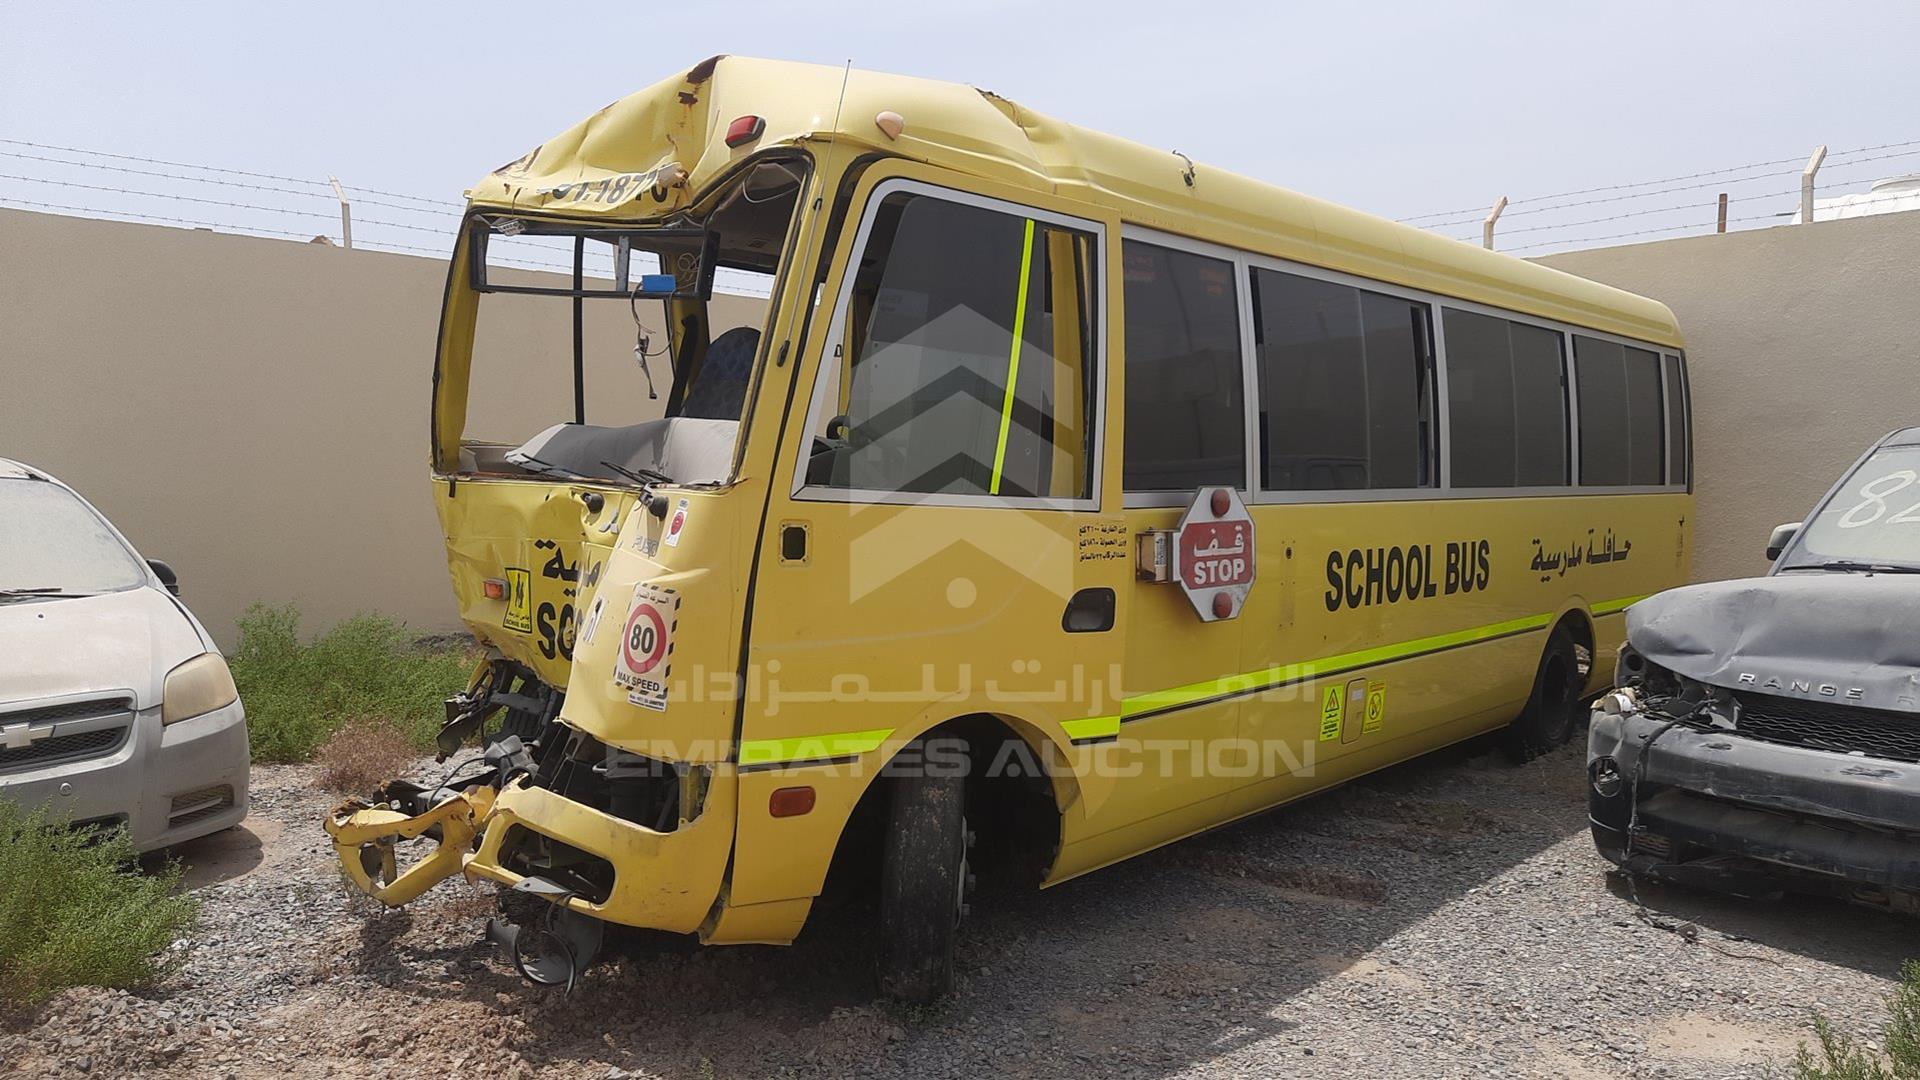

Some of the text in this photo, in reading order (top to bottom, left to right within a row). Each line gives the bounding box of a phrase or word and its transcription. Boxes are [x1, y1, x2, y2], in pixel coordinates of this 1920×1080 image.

[1194, 524, 1245, 557] قف
[1586, 527, 1632, 565] حافلة
[1194, 558, 1245, 585] STOP
[1325, 539, 1490, 612] SCHOOL BUS
[1530, 538, 1583, 583] مدرسية
[630, 624, 654, 654] 80
[617, 672, 660, 692] MAX SPEED
[1738, 672, 1865, 700] RANGE
